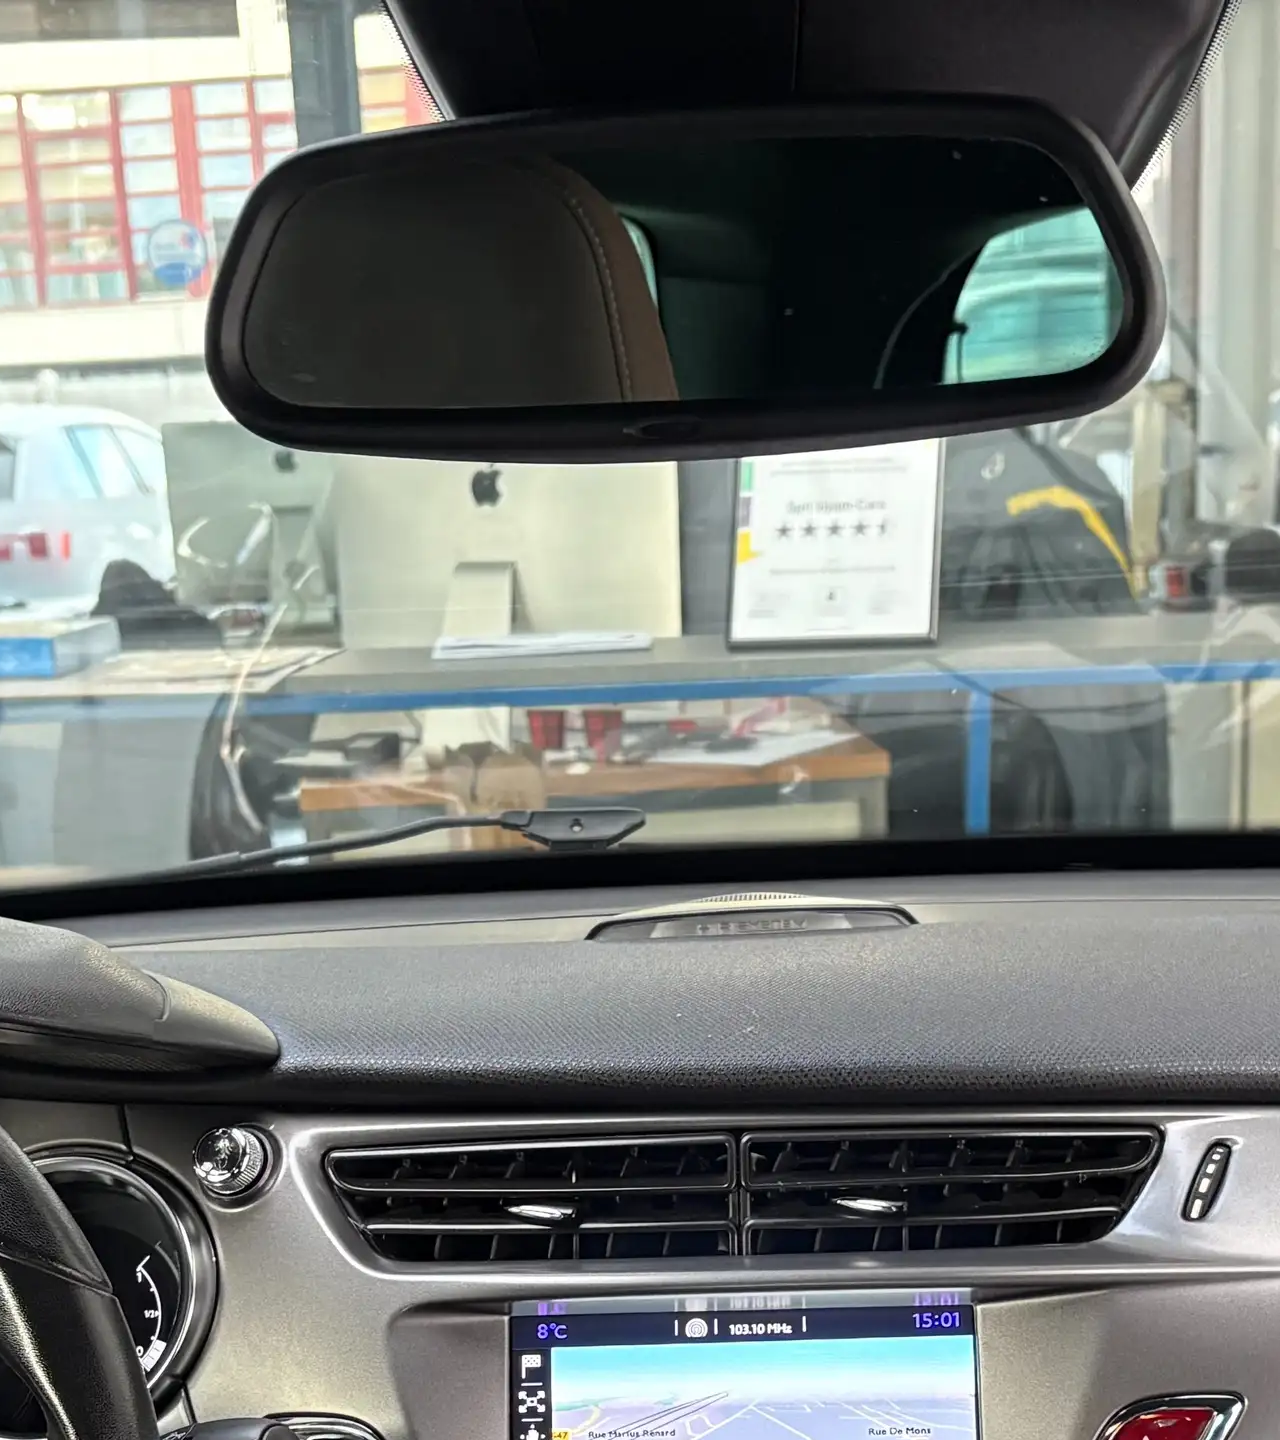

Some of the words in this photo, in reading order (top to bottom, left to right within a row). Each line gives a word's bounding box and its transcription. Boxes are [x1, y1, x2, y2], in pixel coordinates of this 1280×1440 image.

[912, 1311, 960, 1328] 15:01
[537, 1323, 568, 1339] 8°C
[728, 1322, 766, 1336] 103.10
[768, 1322, 793, 1335] MHz
[136, 1346, 144, 1357] 0
[588, 1431, 606, 1439] Rue
[868, 1427, 887, 1436] Rue
[890, 1427, 902, 1436] De
[906, 1427, 931, 1435] Mons
